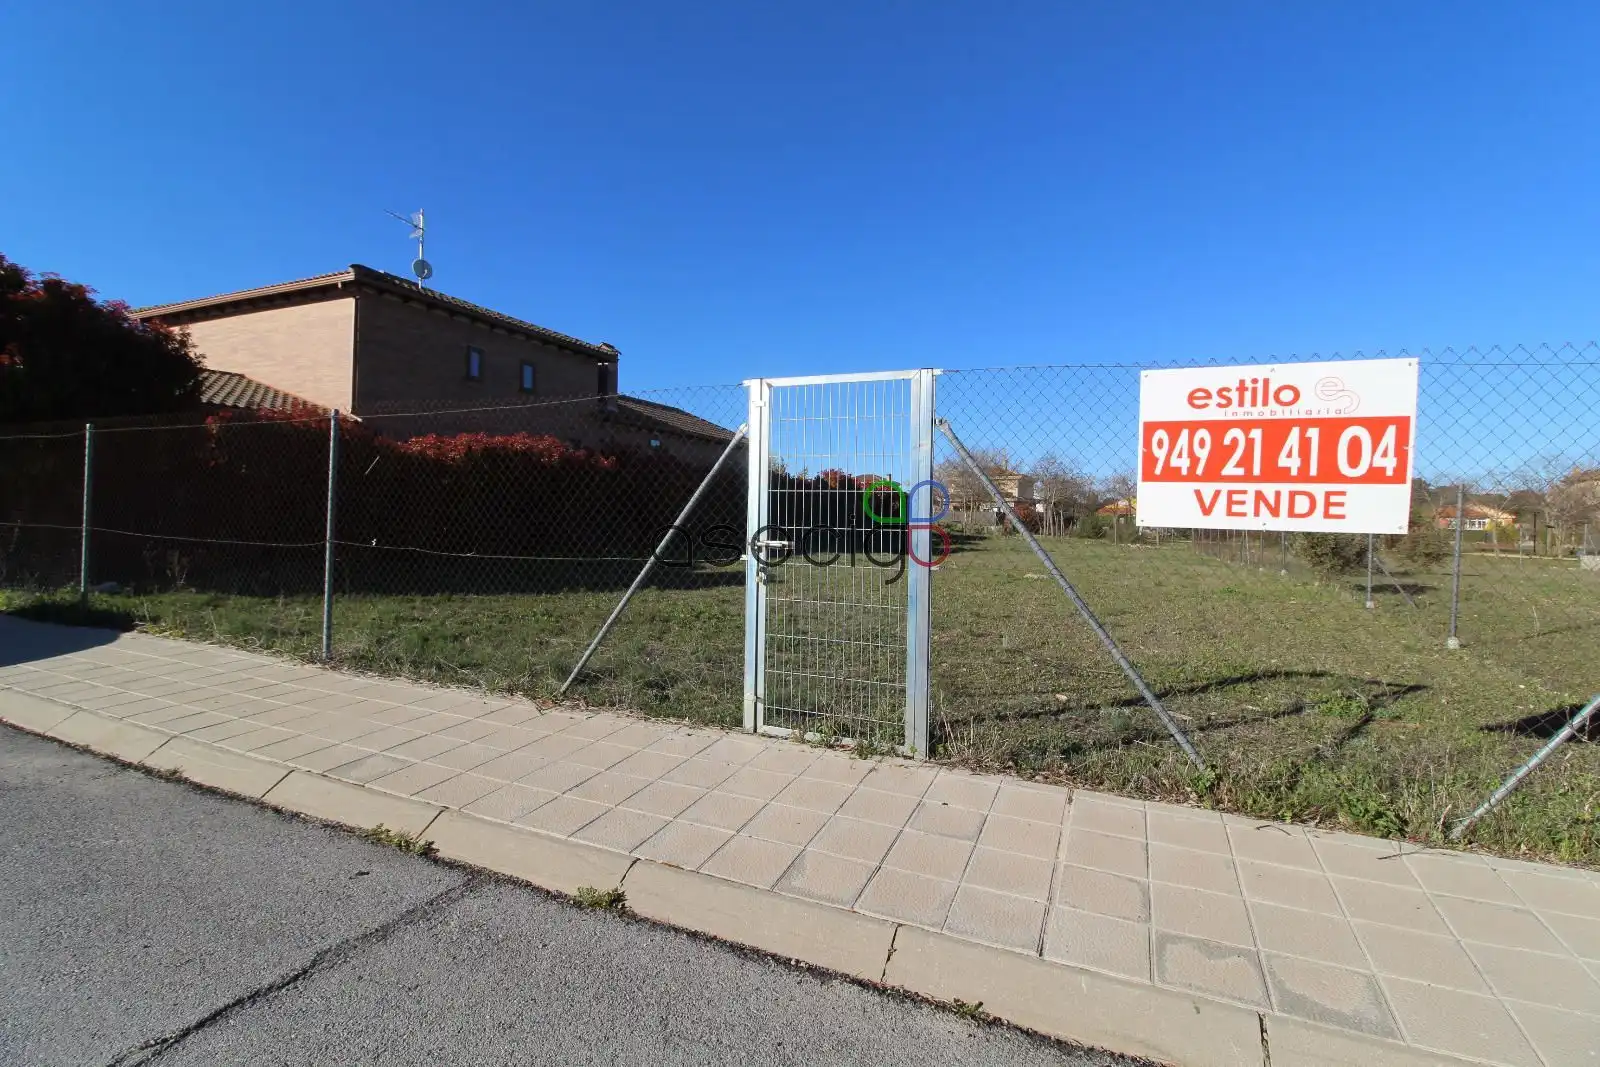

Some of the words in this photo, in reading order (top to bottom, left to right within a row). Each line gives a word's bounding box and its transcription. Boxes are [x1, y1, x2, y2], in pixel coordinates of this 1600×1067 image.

[1187, 378, 1300, 409] estilo
[1224, 407, 1343, 417] inmobiliaria
[1151, 428, 1212, 476] 949
[1220, 427, 1263, 477] 21
[1277, 426, 1320, 477] 41
[1337, 425, 1398, 478] 04
[1194, 489, 1347, 520] VENDE
